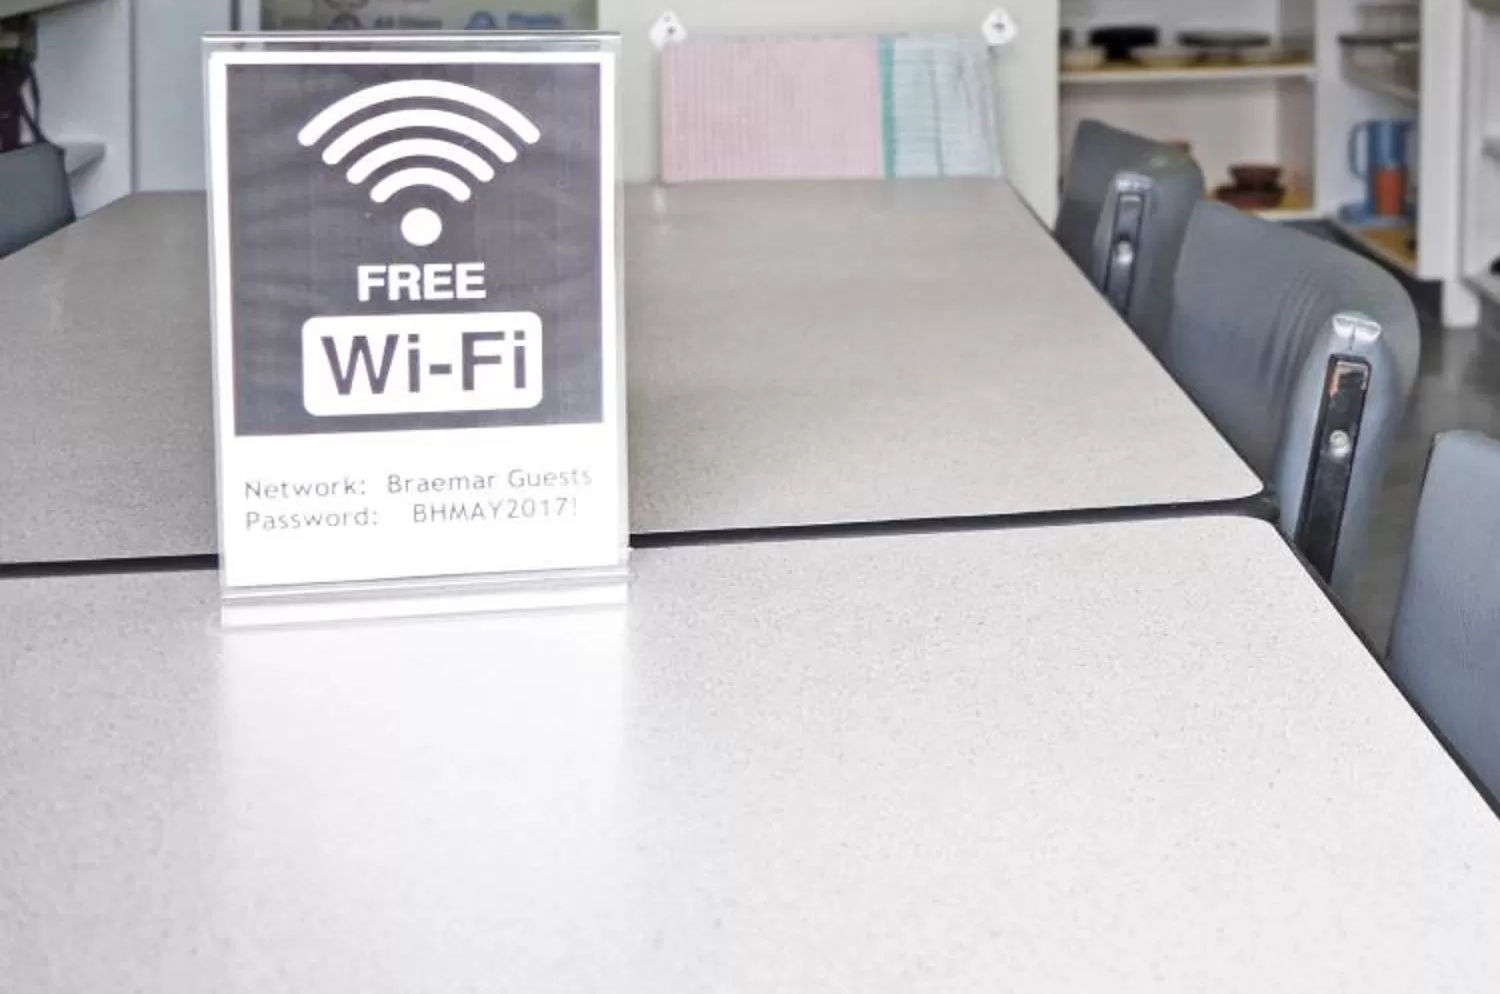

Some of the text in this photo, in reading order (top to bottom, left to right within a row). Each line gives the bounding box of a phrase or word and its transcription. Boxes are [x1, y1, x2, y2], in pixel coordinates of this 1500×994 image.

[357, 262, 486, 302] FREE
[321, 330, 527, 395] Wi-Fi
[244, 466, 593, 500] Network: Braemar Guests
[245, 497, 578, 531] Password: BHMAY2017!
